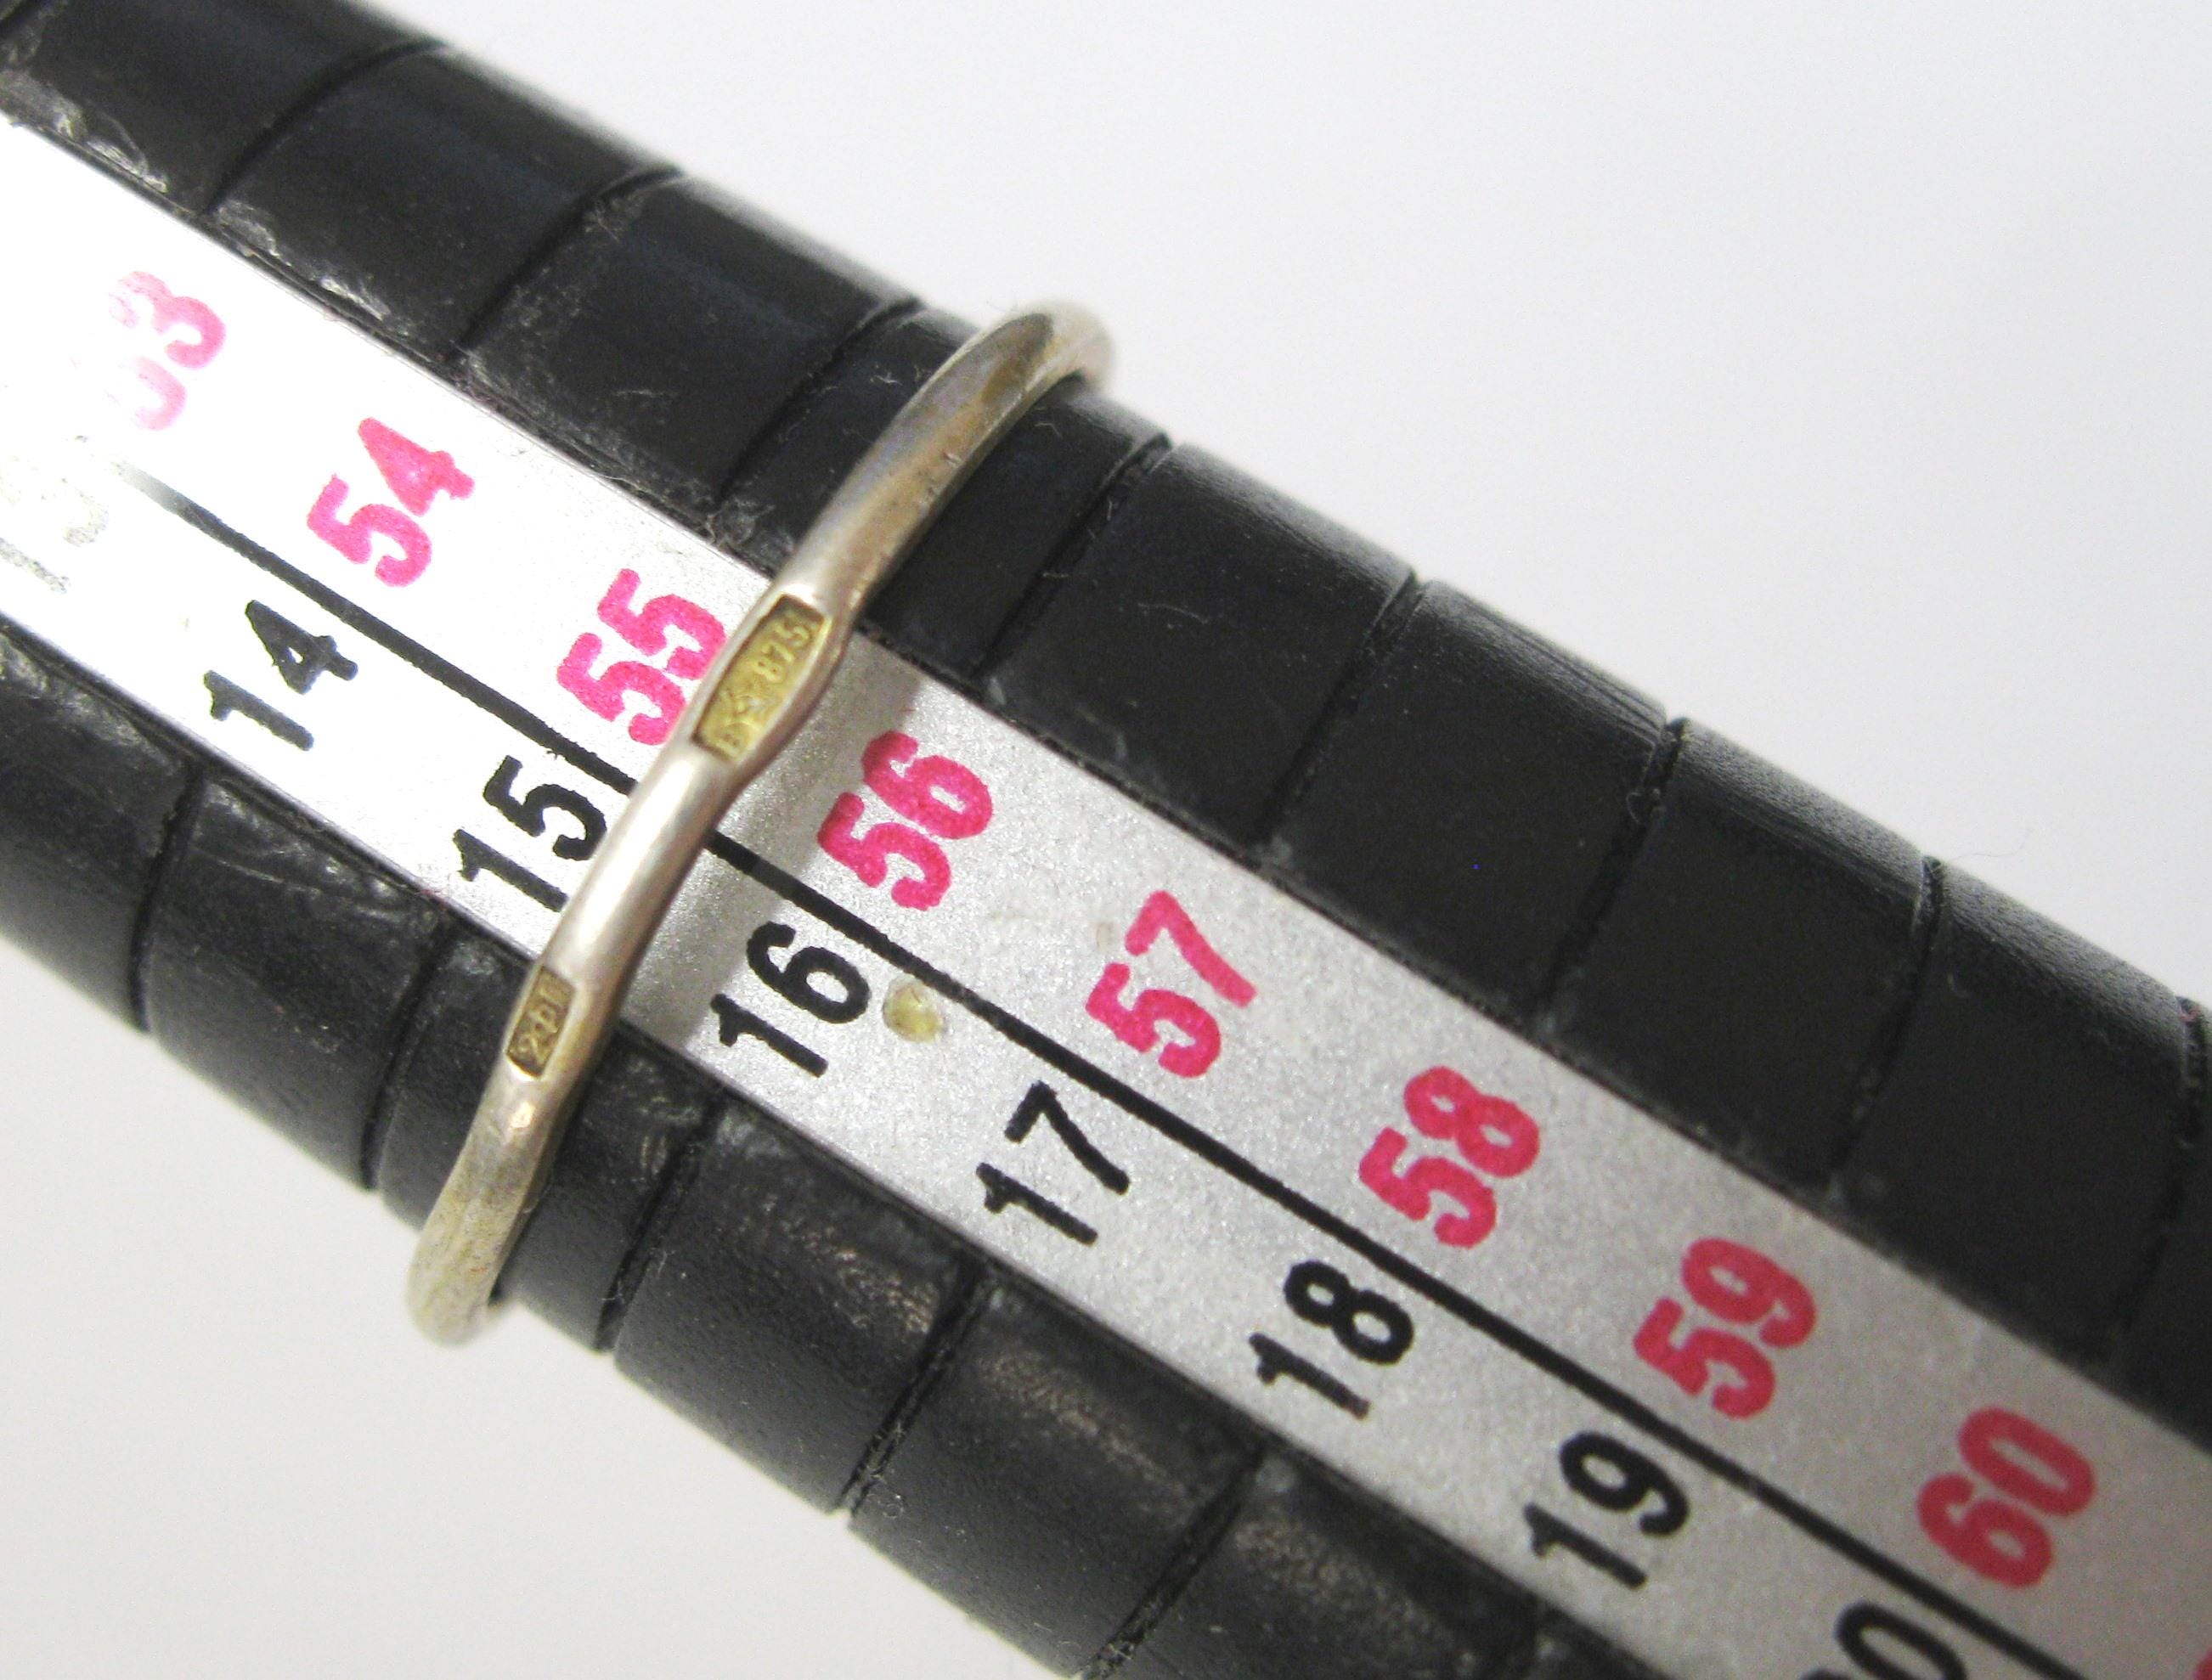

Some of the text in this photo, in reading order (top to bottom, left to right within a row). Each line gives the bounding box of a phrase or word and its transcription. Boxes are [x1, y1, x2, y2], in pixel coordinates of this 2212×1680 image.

[308, 418, 474, 586] 54
[204, 600, 358, 750] 14
[557, 568, 726, 746] 55
[453, 755, 607, 912] 15
[816, 730, 993, 911] 56
[710, 922, 870, 1077] 16
[1085, 890, 1257, 1079] 57
[976, 1080, 1129, 1245] 17
[1358, 1065, 1541, 1250] 58
[1249, 1261, 1414, 1419] 18
[1633, 1237, 1818, 1421] 59
[1523, 1431, 1690, 1590] 19
[1915, 1405, 2096, 1590] 60
[1797, 1601, 1967, 1680] 0
